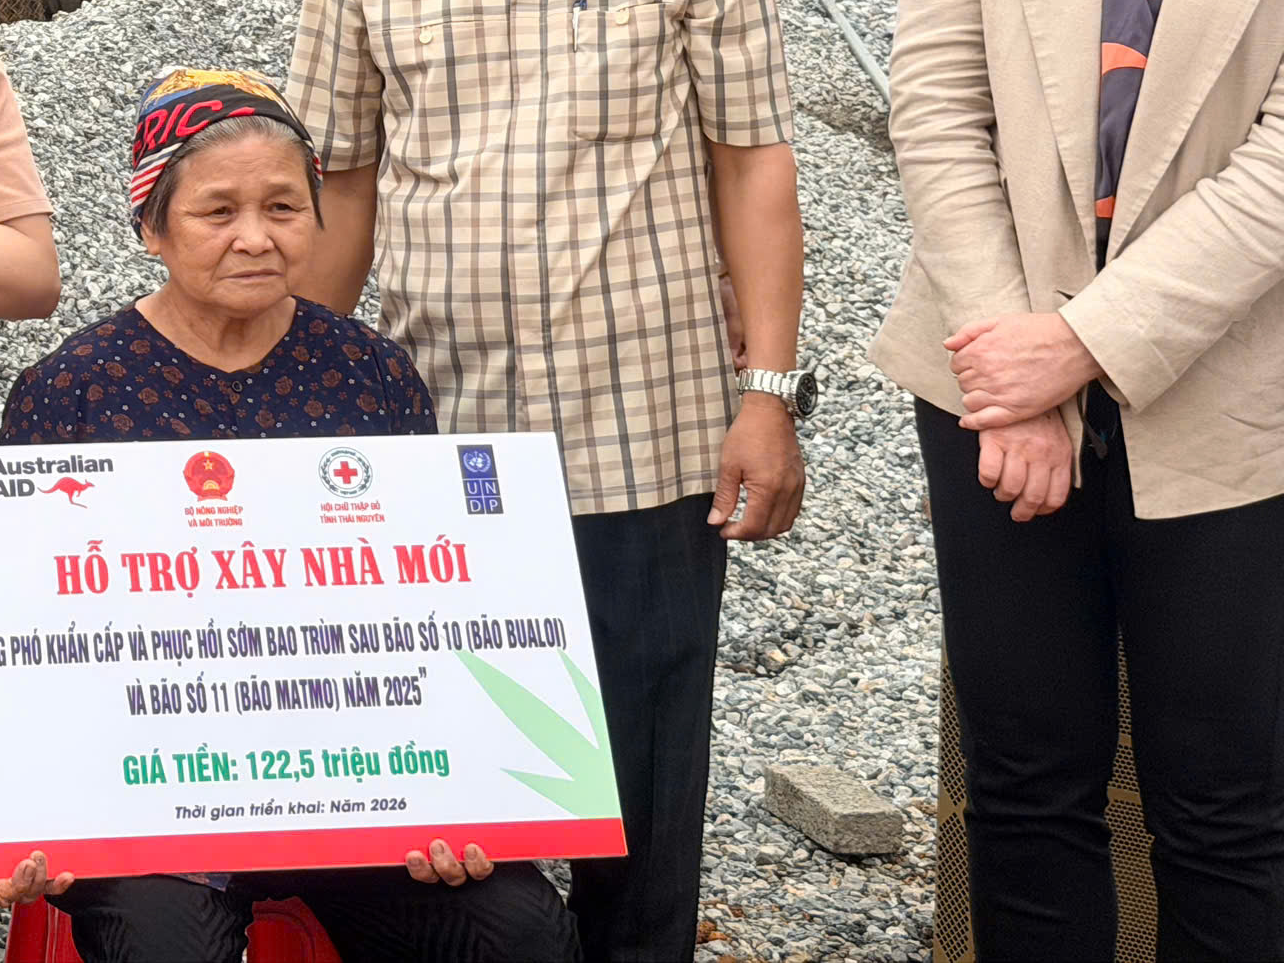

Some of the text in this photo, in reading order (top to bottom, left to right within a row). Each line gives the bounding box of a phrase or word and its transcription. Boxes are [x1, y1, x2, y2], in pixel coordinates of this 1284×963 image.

[196, 506, 216, 515] NÔNG
[217, 505, 244, 515] NGHIỆP
[320, 502, 333, 512] HỘI
[320, 513, 385, 524] TỈNH THÁI NGUYÊN
[188, 517, 243, 527] VÀ MÔI TRƯỜNG
[53, 534, 472, 598] HỖ TRỢ XÂY NHÀ MỚI
[10, 628, 42, 666] PHÓ
[46, 621, 90, 664] KHẨN
[93, 621, 124, 663] CẤP
[127, 624, 149, 661] VÀ
[151, 629, 194, 667] PHỤC
[196, 618, 224, 659] HỒI
[227, 621, 264, 657] SỚM
[265, 625, 298, 656] BAO
[300, 618, 346, 655] TRÙM
[348, 623, 380, 654] SAU
[382, 616, 415, 652] BÃO
[418, 610, 440, 652] SỐ
[442, 621, 463, 651] 10
[465, 614, 503, 653] (BÃO
[505, 618, 567, 650] BUALOI)
[126, 678, 148, 716] VÀ
[149, 678, 182, 715] BÃO
[186, 671, 208, 714] SỐ
[211, 682, 229, 713] 11
[234, 675, 272, 715] (BÃO
[275, 678, 339, 711] MATMO)
[342, 670, 381, 708] NĂM
[122, 740, 451, 786] GIÁ TIỀN: 122,5 triệu đồng
[174, 797, 408, 821] Thời gian triển khai: Năm 2026
